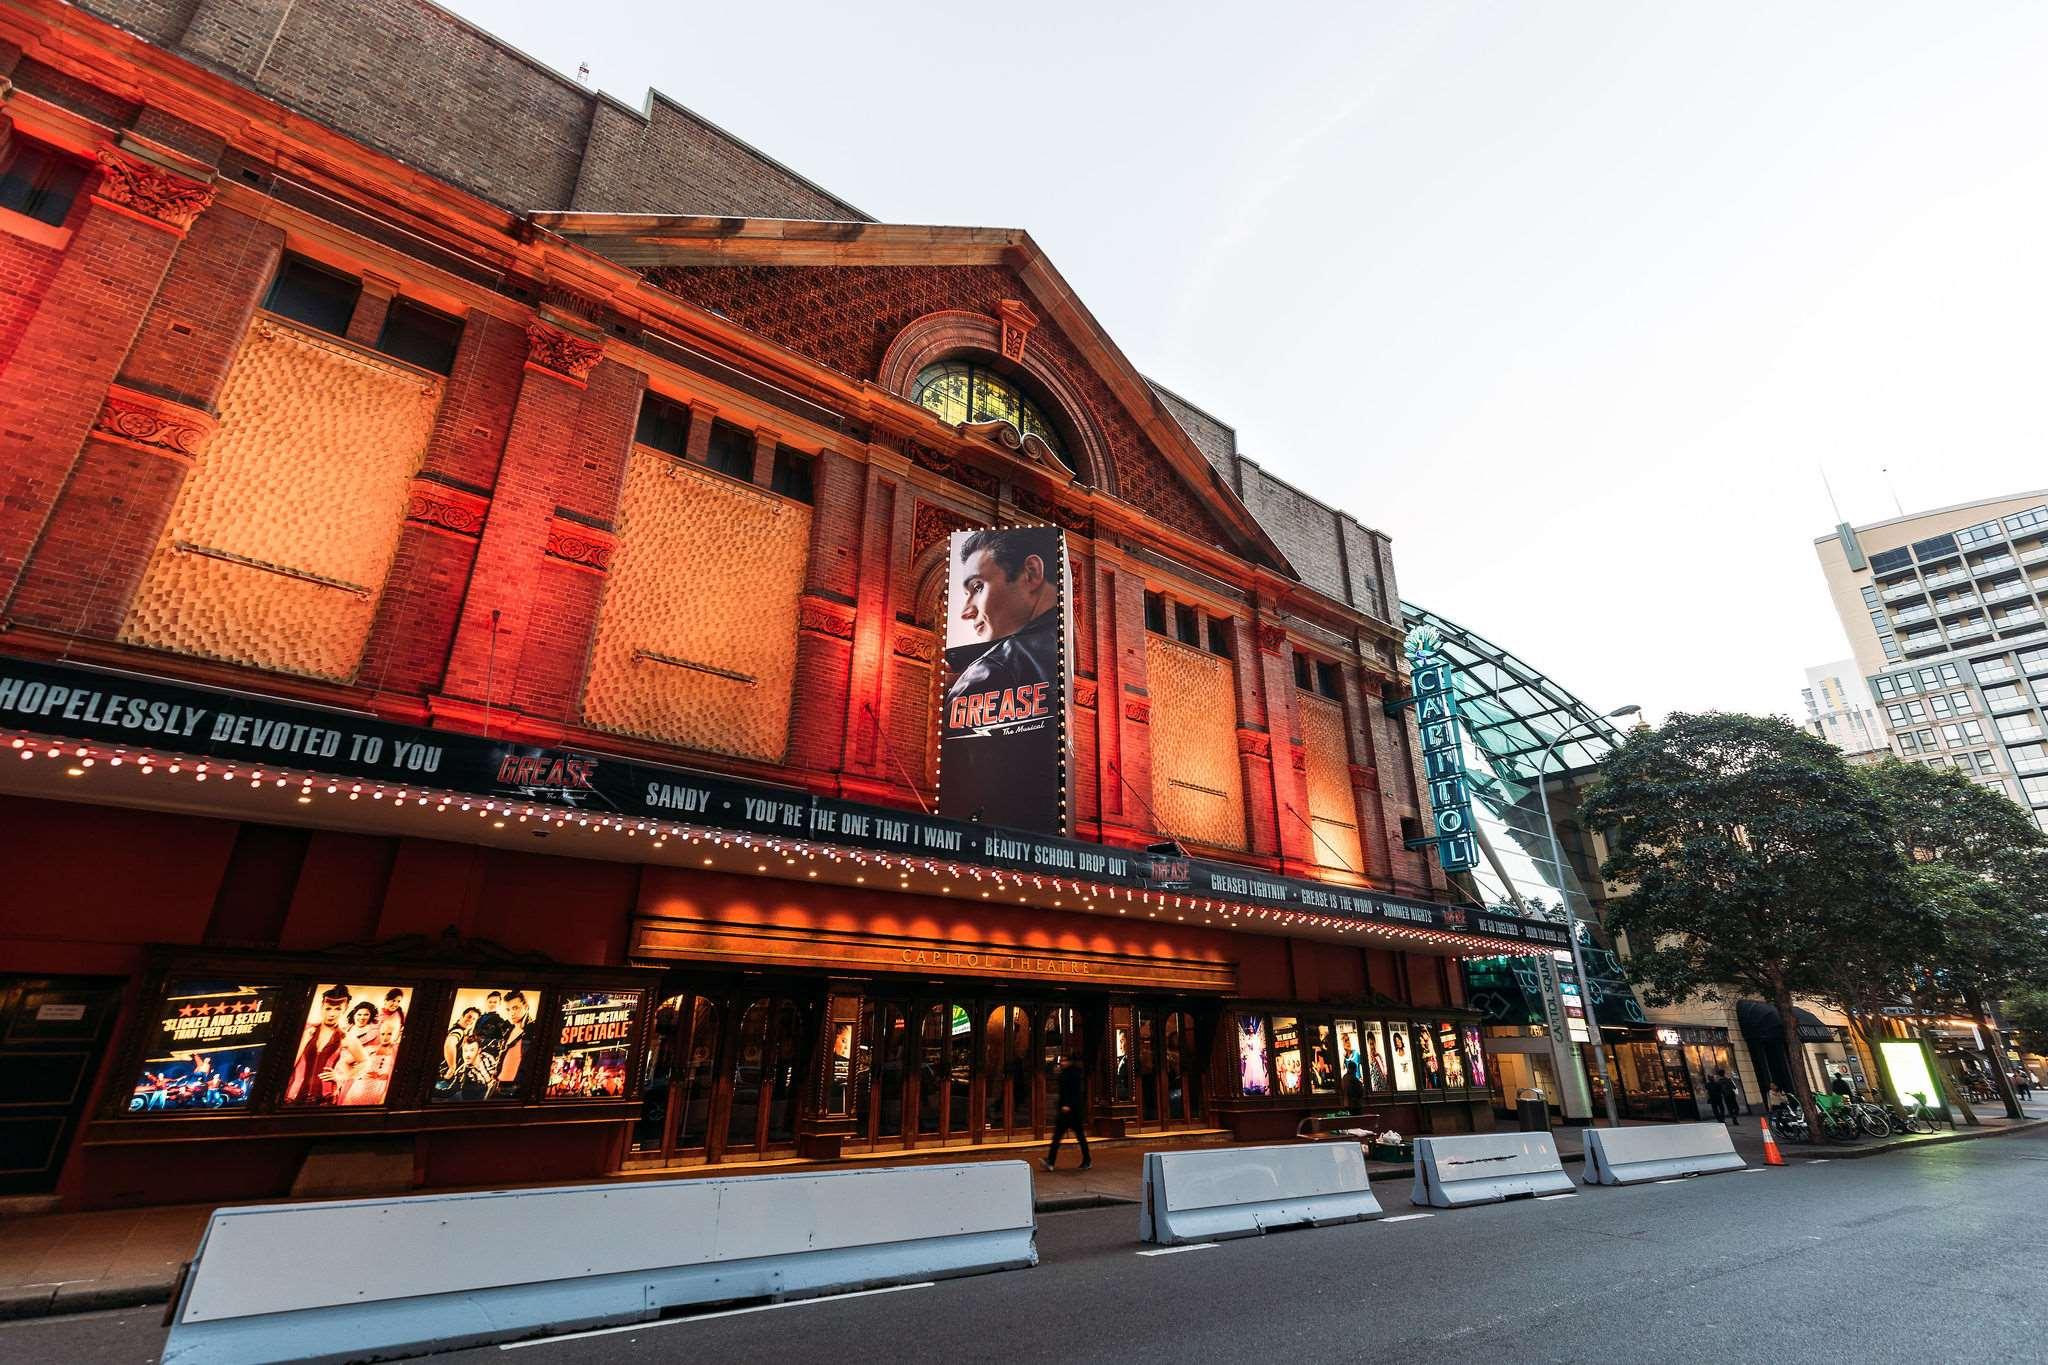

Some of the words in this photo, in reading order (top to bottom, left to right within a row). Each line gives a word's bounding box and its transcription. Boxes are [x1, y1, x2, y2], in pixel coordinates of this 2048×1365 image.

[950, 681, 1050, 729] GREASE
[0, 677, 207, 737] HOPELESSLY
[210, 712, 342, 758] DEVOTED
[349, 733, 384, 764] TO
[393, 740, 443, 773] YOU
[1001, 725, 1014, 736] The
[1014, 720, 1045, 734] Musical
[496, 755, 599, 789] GREASE
[1417, 670, 1465, 863] CAPITOL
[645, 782, 711, 813] SANDY
[744, 797, 804, 827] YOU'RE
[808, 807, 837, 833] THE
[841, 813, 870, 837] ONE
[875, 818, 910, 843] THAT
[913, 824, 919, 844] I
[924, 826, 964, 851] WANT
[985, 836, 1031, 862] BEAUTY
[1034, 845, 1076, 869] SCHOOL
[1079, 855, 1105, 873] DROP
[1109, 858, 1128, 877] OUT
[1211, 873, 1248, 895] GREASED
[1301, 888, 1328, 907] GREASE
[1329, 893, 1338, 909] IS
[1338, 895, 1352, 911] THE
[1353, 897, 1373, 914] WORD
[1382, 902, 1410, 920] SUMMER
[1410, 906, 1433, 923] NIGHTS
[901, 948, 993, 968] CAPITOL
[1007, 956, 1090, 975] THEATRE
[1538, 954, 1554, 993] SQUAR
[173, 1028, 198, 1040] THAN
[198, 1026, 222, 1038] EVEN
[210, 1014, 234, 1027] AND
[234, 1011, 272, 1025] SEXIER
[574, 1009, 630, 1026] HIGH-OCTANE
[1547, 996, 1564, 1043] CAPITOL
